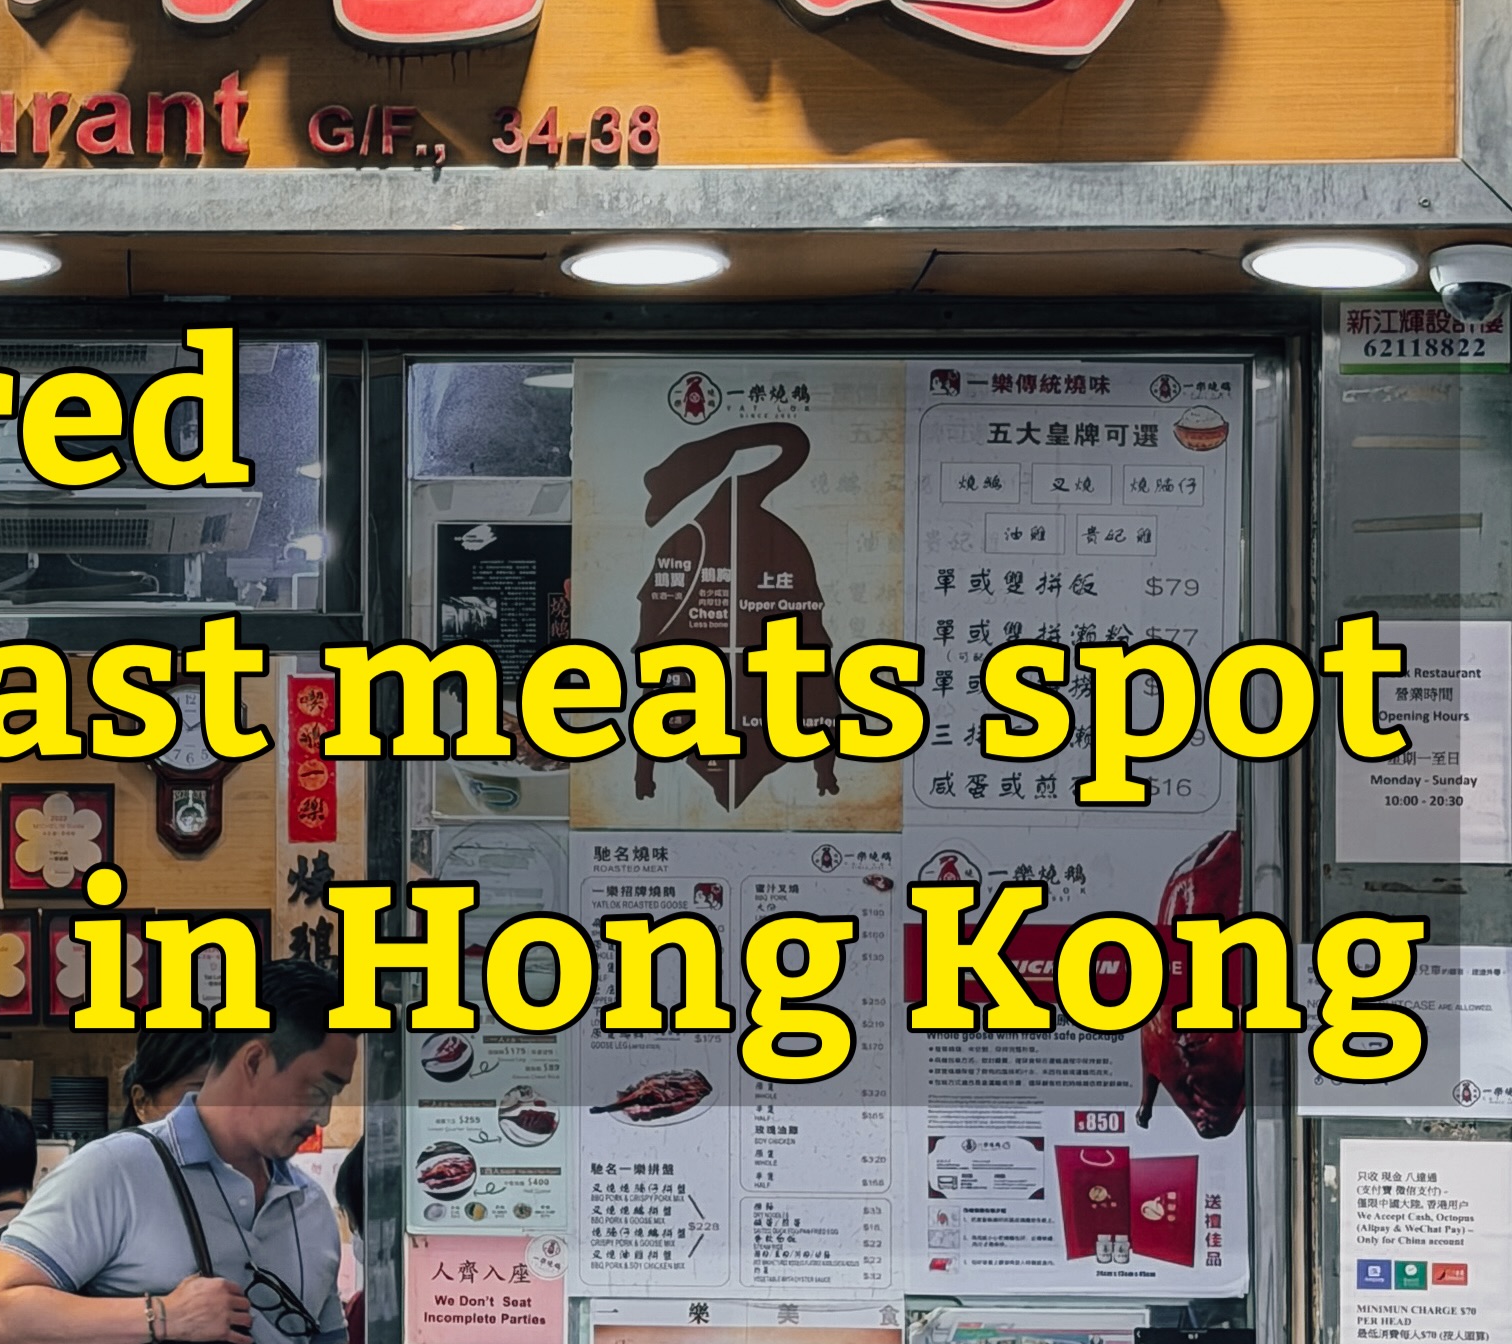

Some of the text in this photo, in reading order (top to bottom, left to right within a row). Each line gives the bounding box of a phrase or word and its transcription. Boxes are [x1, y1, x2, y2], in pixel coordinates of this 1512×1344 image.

[492, 105, 661, 156] 34-38
[1364, 338, 1485, 356] 62118822
[967, 373, 1111, 395] 一樂傳統燒味
[987, 422, 1159, 447] 五大皇牌可選
[658, 558, 691, 571] Wing
[1145, 576, 1200, 597] $79
[739, 600, 824, 612] Upper Quarter
[689, 607, 728, 619] Chest
[1414, 668, 1481, 678] Restaurant
[1395, 687, 1453, 702] 營業時間
[1379, 711, 1470, 723] Opening Hours
[1371, 775, 1477, 788] Monday Sunday
[1385, 796, 1463, 806] 10:00 20:30
[435, 1296, 455, 1306] We
[503, 1296, 532, 1307] Seat
[424, 1313, 546, 1326] Incomplete Parties
[1357, 1317, 1412, 1325] PER HEAD
